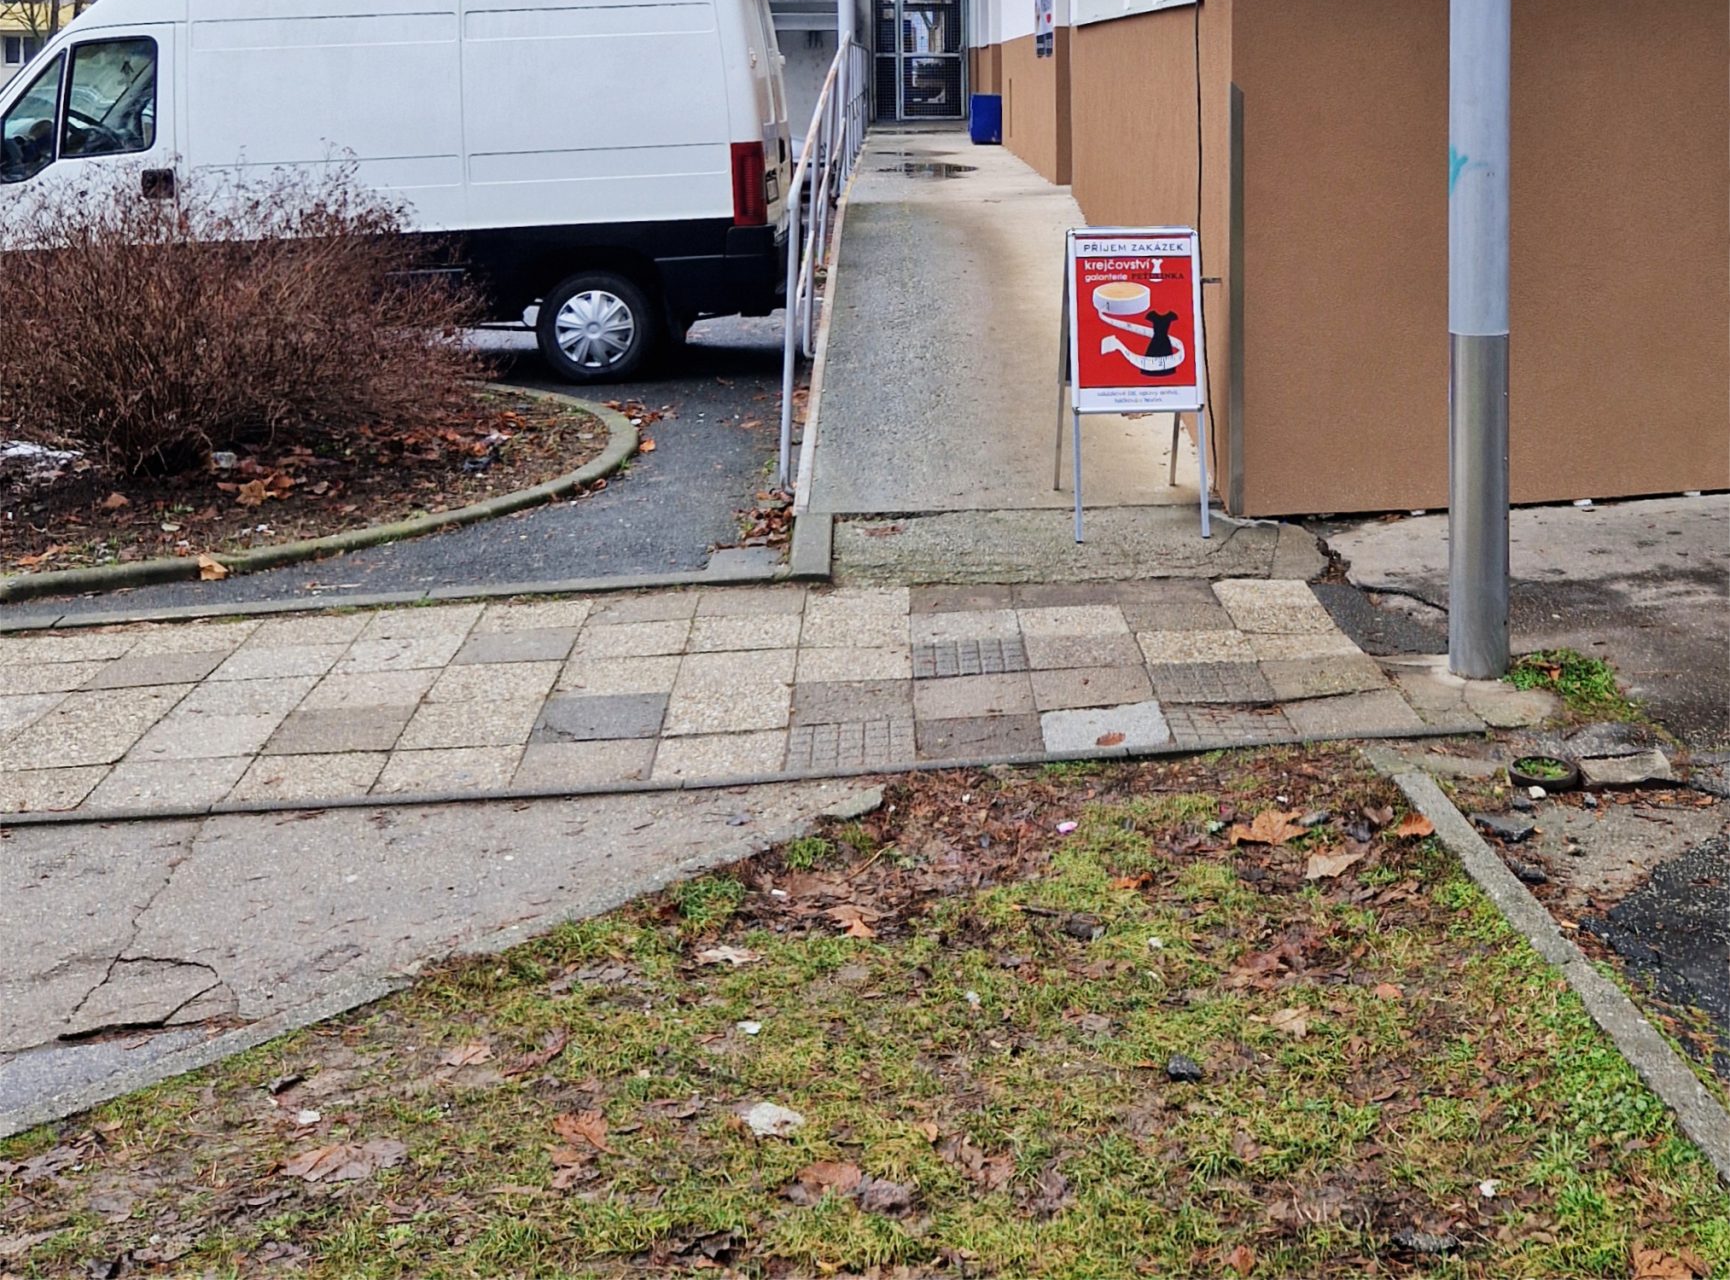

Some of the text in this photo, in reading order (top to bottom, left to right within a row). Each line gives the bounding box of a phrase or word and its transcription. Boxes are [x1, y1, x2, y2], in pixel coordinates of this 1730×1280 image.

[1083, 242, 1184, 252] PŘÍJEM ZAKÁZEK
[1084, 258, 1150, 272] krejčovství
[1085, 273, 1128, 283] galanterie
